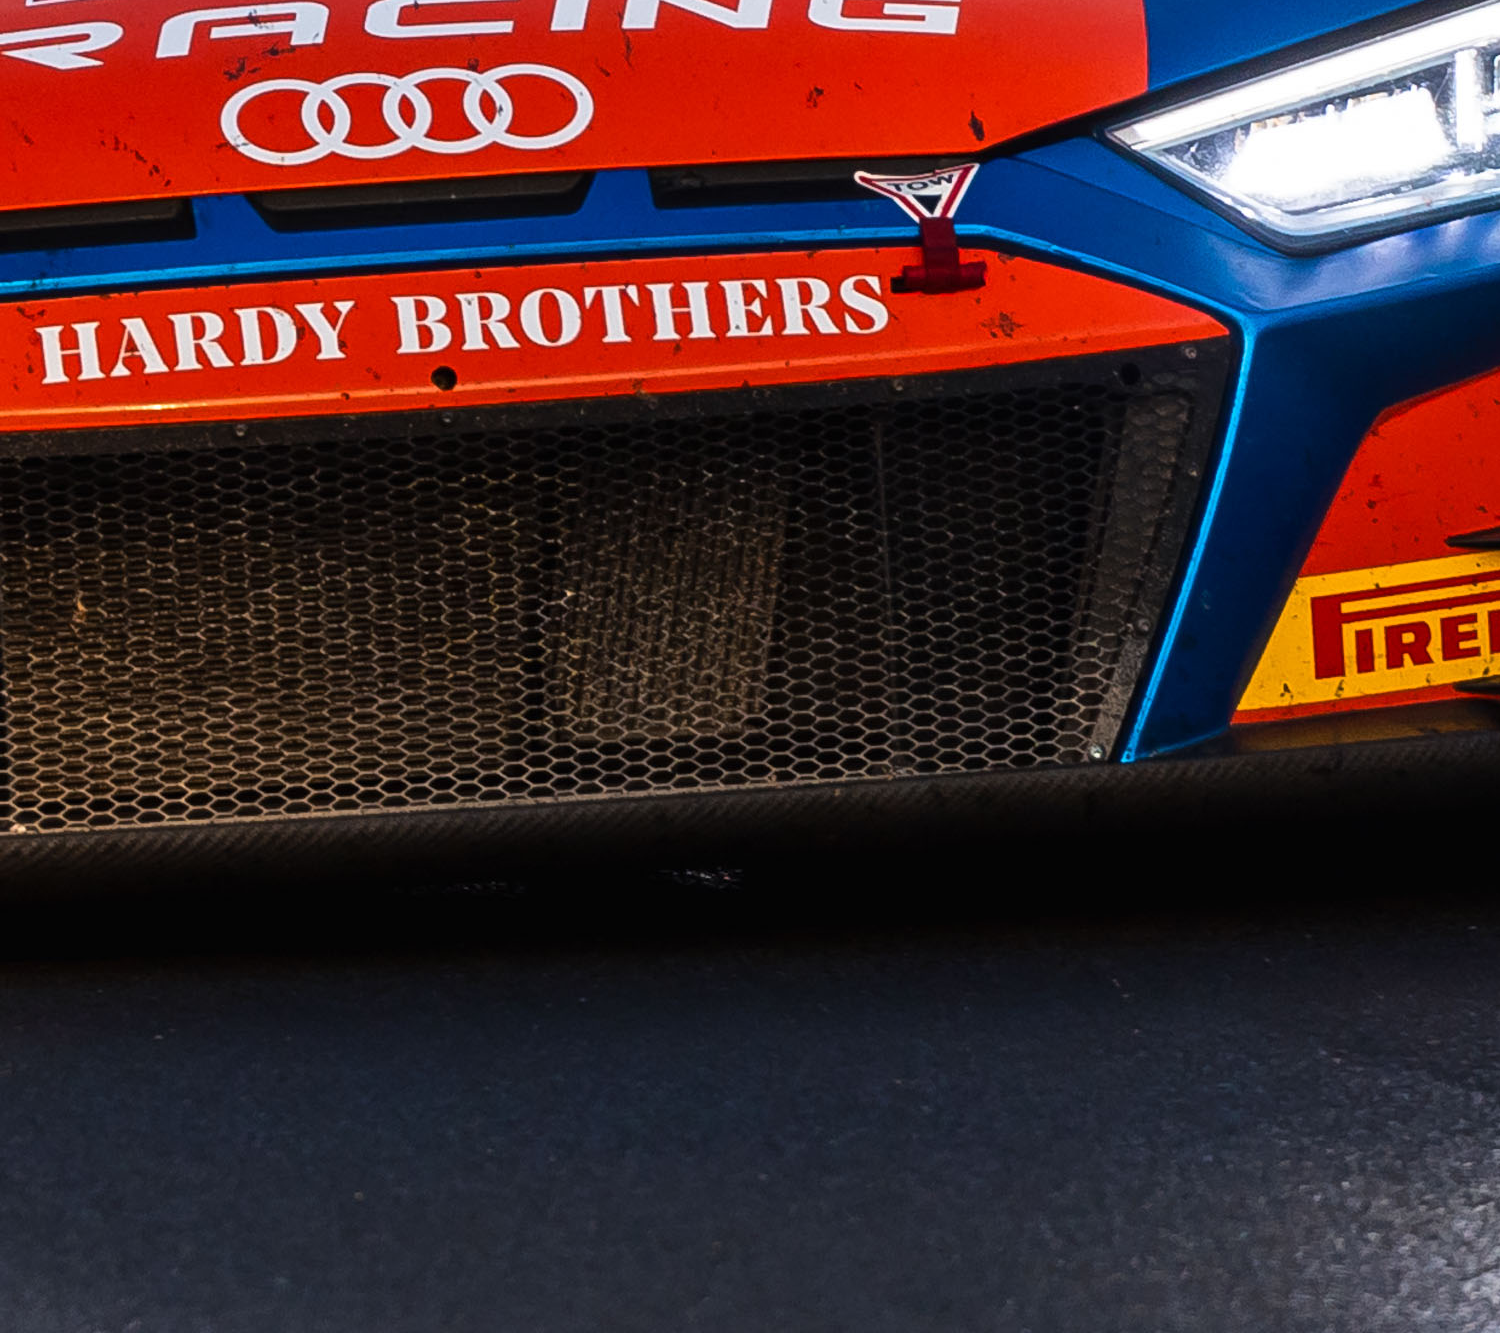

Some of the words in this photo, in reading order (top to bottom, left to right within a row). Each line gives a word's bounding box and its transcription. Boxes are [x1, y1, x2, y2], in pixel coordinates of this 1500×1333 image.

[886, 174, 954, 193] TOW
[35, 299, 356, 385] HARDY
[390, 274, 892, 357] BROTHERS
